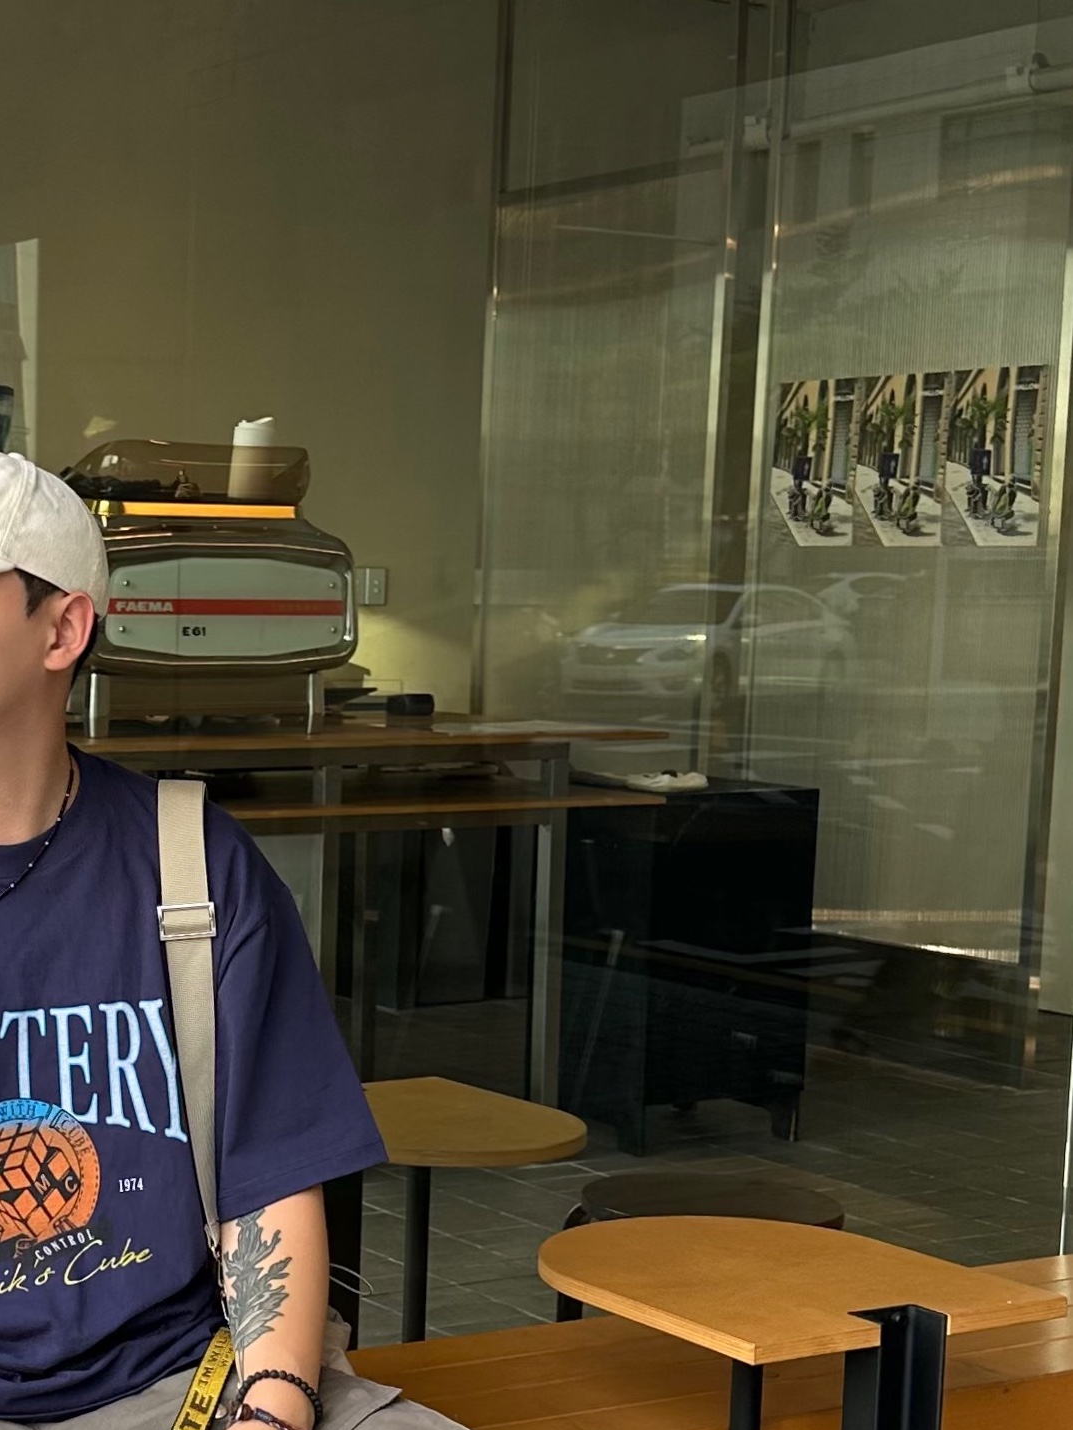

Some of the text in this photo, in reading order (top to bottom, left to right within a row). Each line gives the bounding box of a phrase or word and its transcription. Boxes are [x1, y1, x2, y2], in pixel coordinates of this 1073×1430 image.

[115, 601, 174, 613] FAEMA
[61, 1119, 91, 1156] CUBE
[118, 1177, 144, 1193] 1974
[34, 1228, 96, 1261] CONTROL
[63, 1238, 154, 1286] Cube
